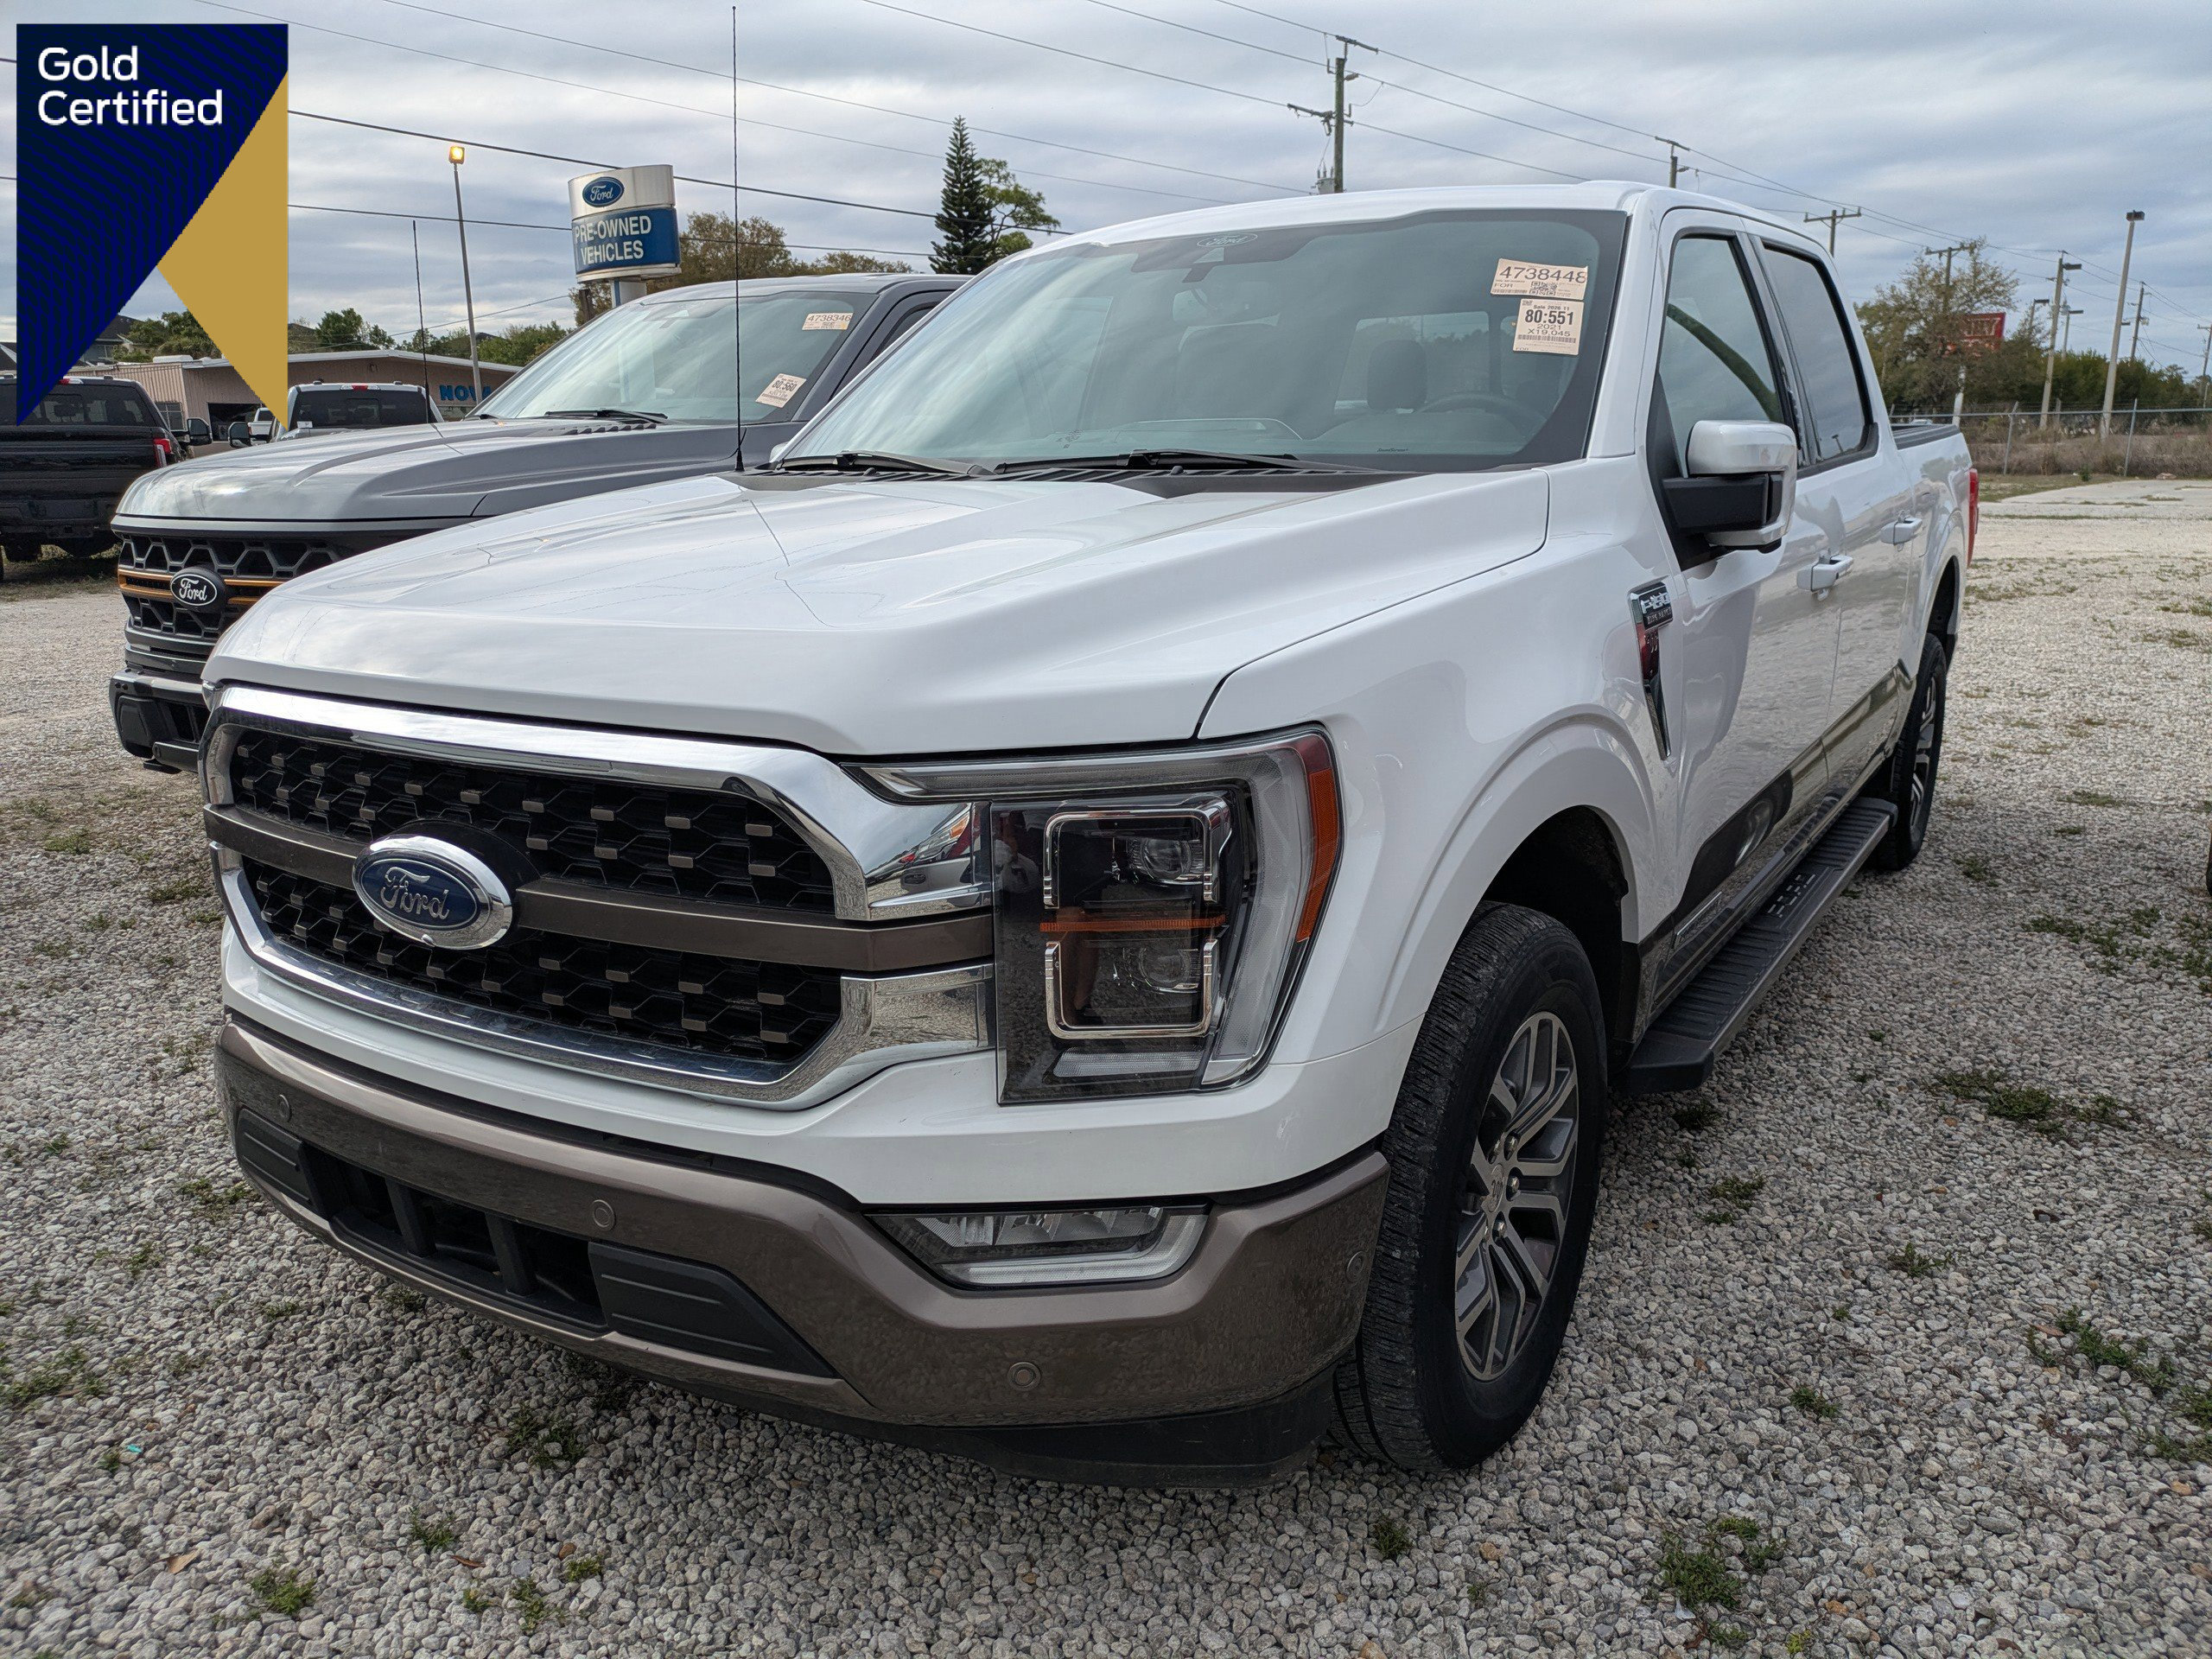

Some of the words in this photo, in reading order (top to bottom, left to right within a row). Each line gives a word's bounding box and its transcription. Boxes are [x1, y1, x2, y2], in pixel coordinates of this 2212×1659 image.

[590, 185, 614, 200] Ford
[575, 215, 652, 245] PRE-OWNED
[581, 239, 645, 266] VEHICLES
[1499, 266, 1586, 283] 4738448
[808, 314, 852, 322] 4738346
[1525, 309, 1573, 325] 80:551
[179, 577, 207, 601] Ford
[380, 867, 449, 919] Ford
